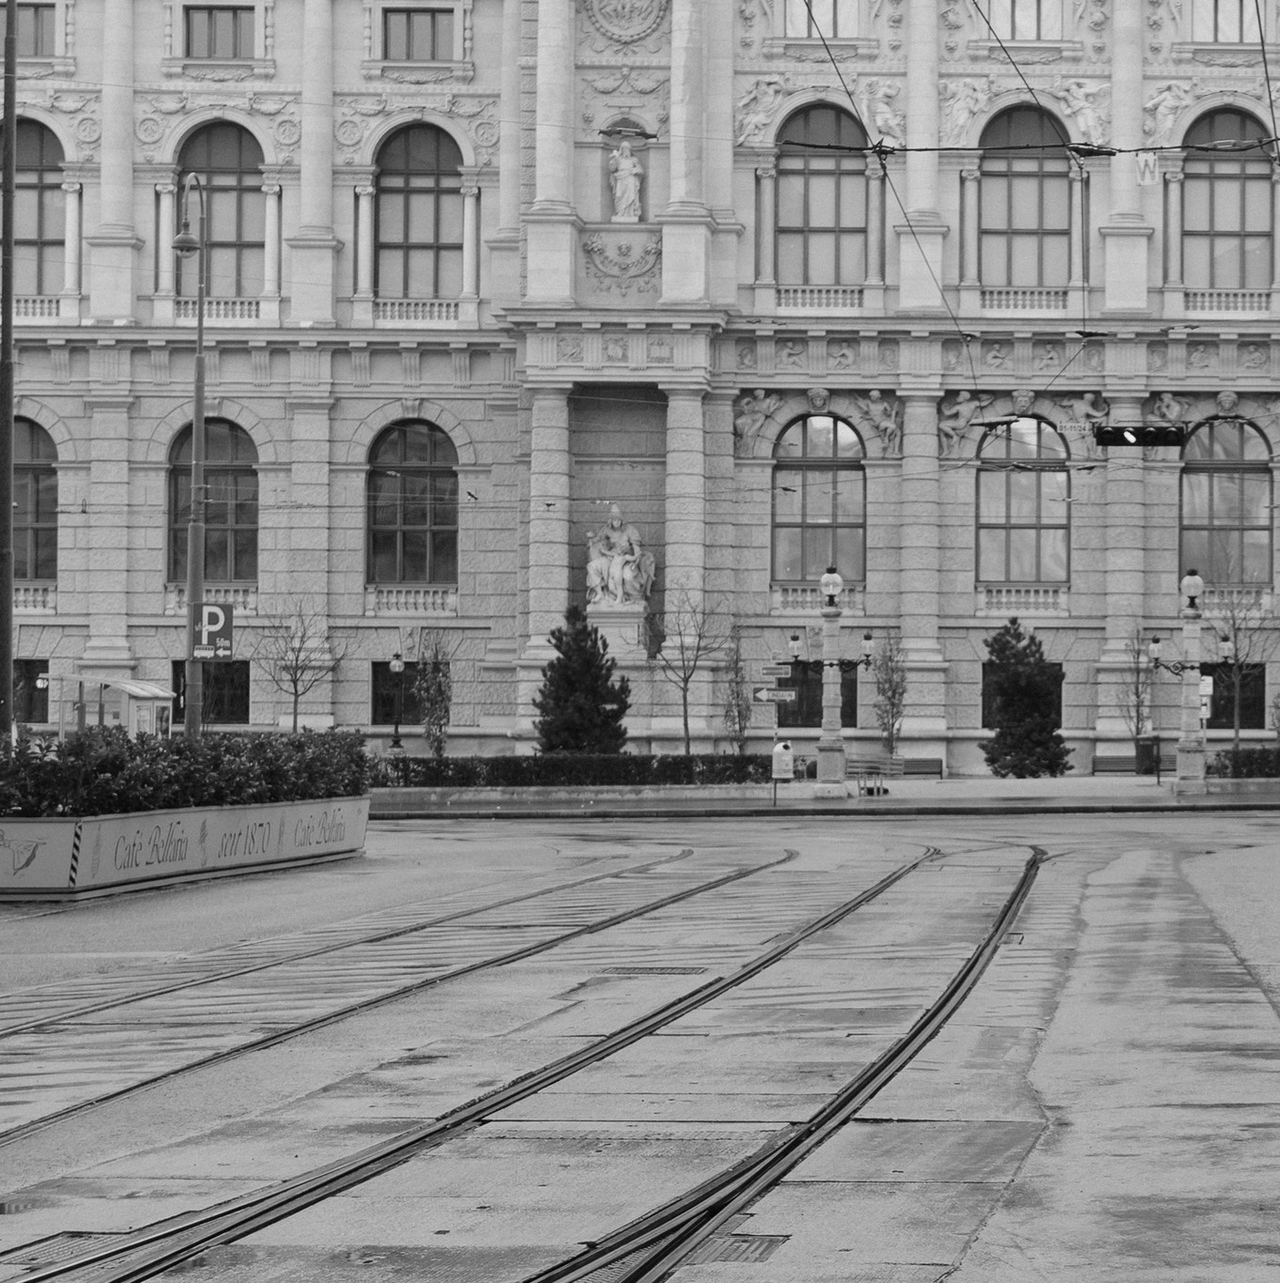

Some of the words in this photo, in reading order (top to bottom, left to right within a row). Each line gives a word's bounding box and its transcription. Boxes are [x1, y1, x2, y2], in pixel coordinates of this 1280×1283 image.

[1135, 158, 1156, 181] W
[202, 605, 225, 645] P
[216, 637, 230, 647] 50m
[114, 829, 143, 870] Café
[146, 821, 188, 866] Bellaria
[218, 829, 242, 858] seit
[244, 821, 271, 856] 1870
[294, 814, 315, 848] Café
